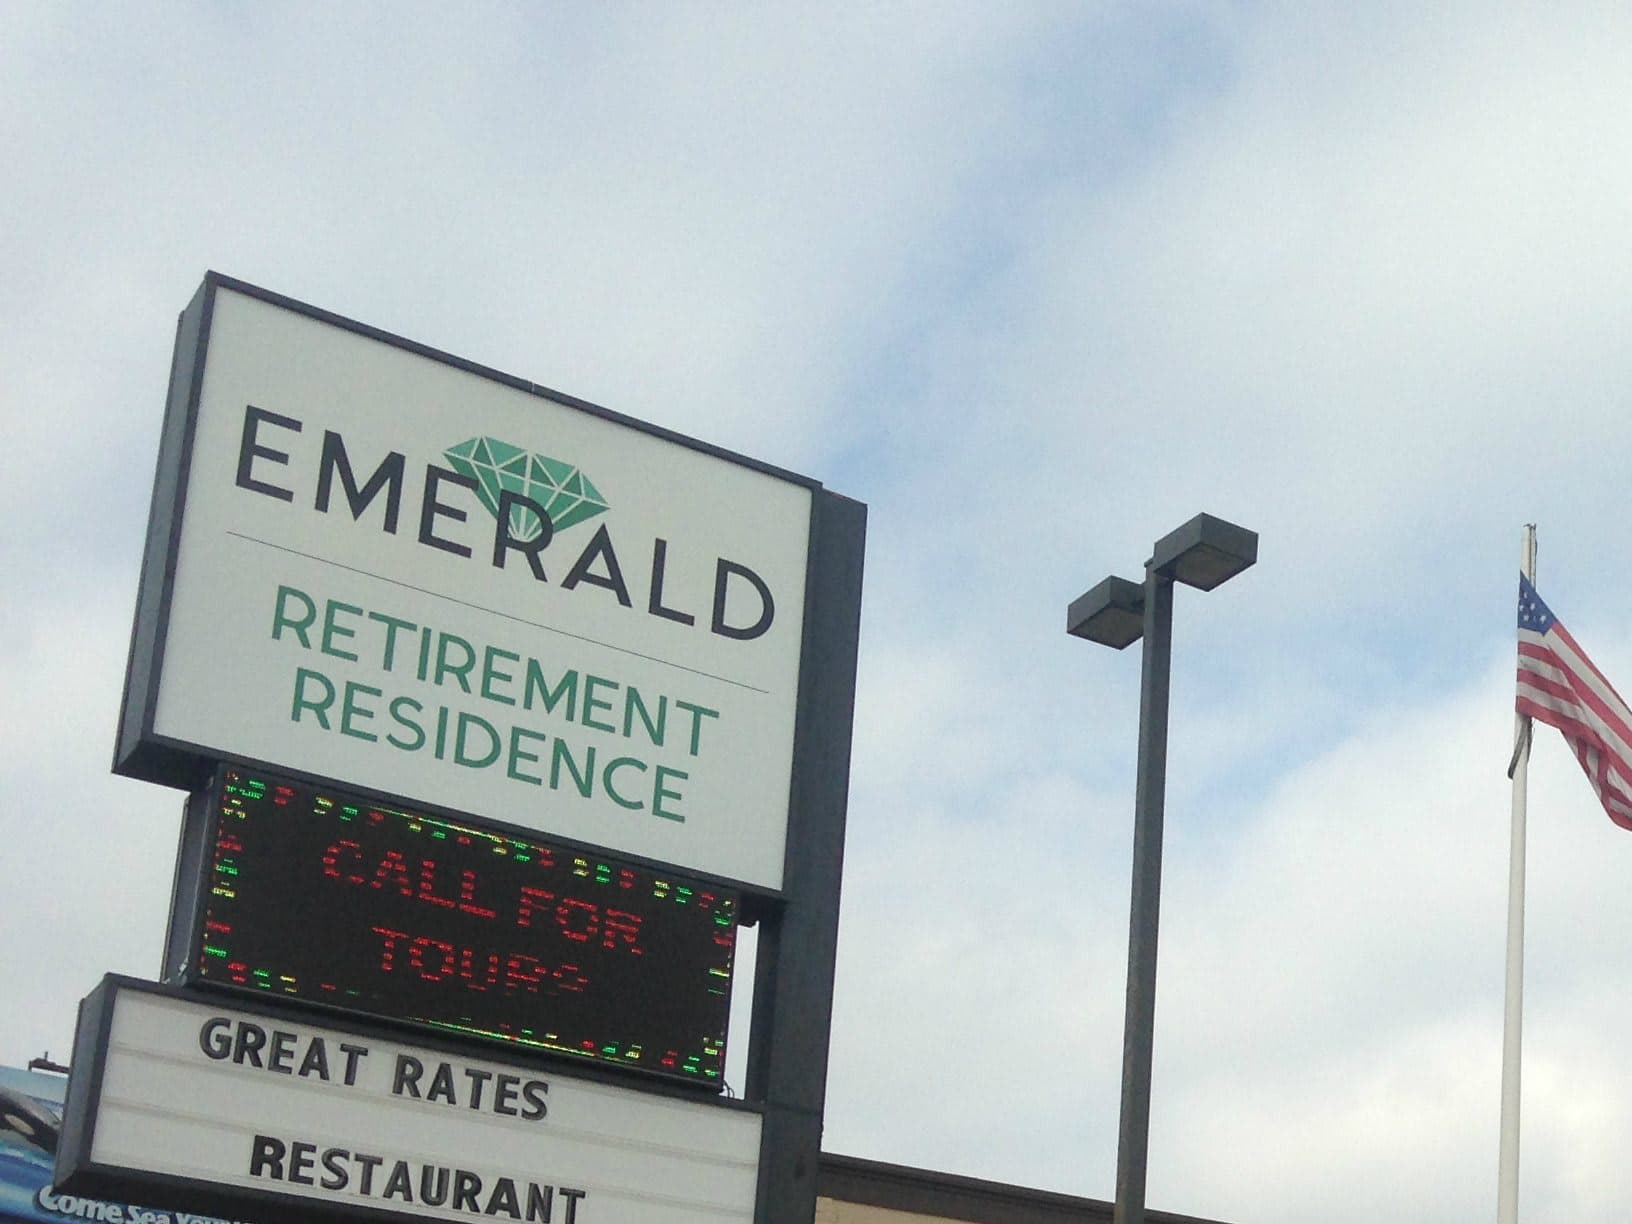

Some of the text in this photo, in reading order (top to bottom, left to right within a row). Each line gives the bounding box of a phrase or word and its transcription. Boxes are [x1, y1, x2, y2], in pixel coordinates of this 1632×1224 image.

[235, 405, 775, 641] EMERALD
[272, 586, 719, 757] RETIREMENT
[290, 668, 691, 823] RESIDENCE
[322, 839, 643, 955] CALL FOR
[200, 1017, 549, 1121] GREAT RATES
